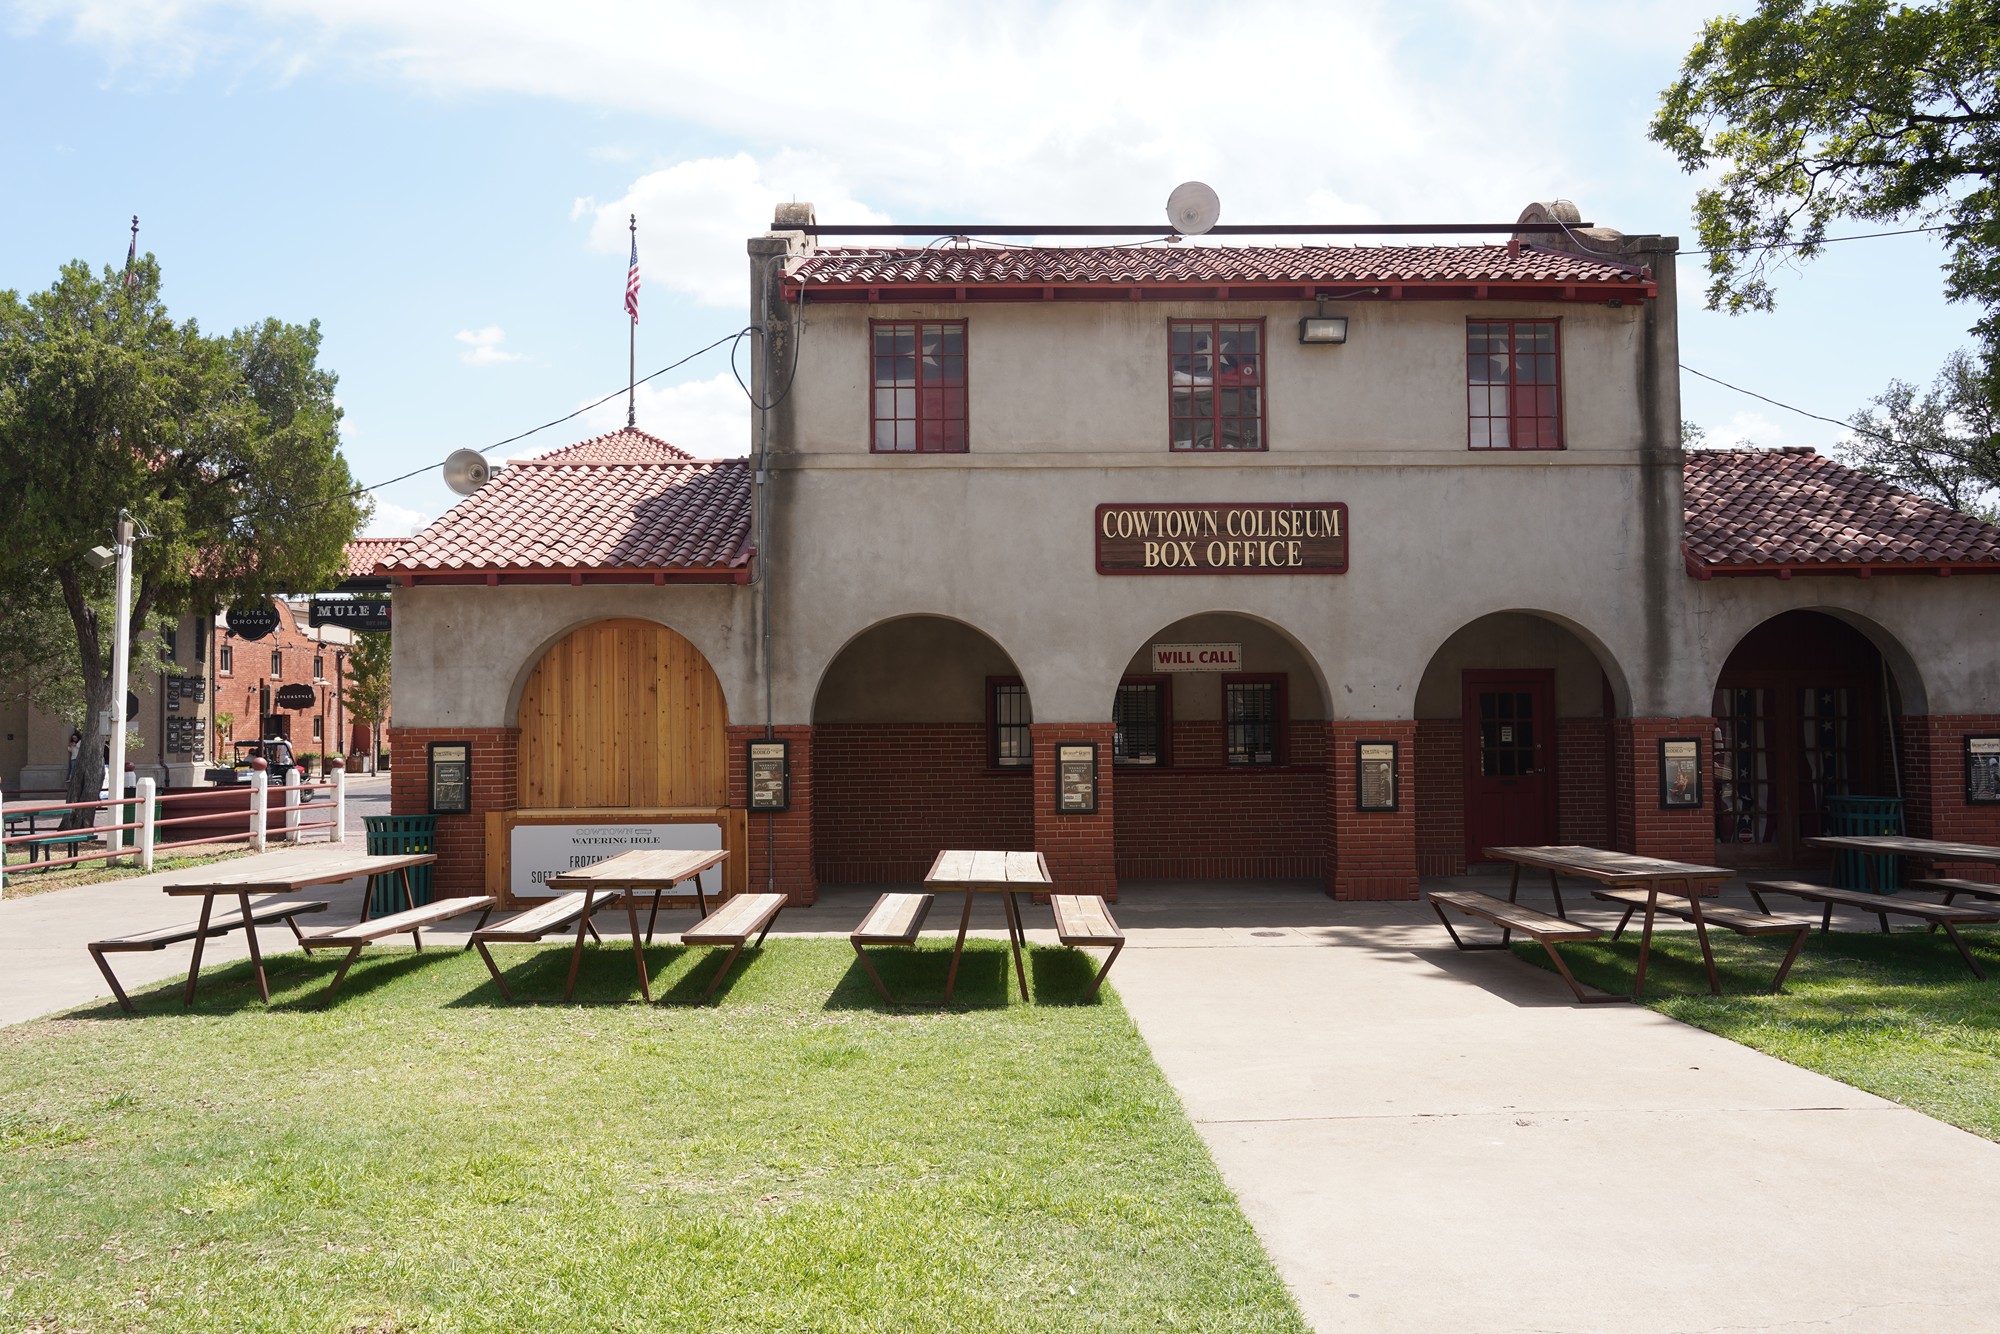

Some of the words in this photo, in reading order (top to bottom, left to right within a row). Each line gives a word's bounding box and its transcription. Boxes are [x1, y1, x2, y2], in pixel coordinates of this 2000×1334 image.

[1102, 510, 1218, 538] COWTOWN
[1226, 509, 1341, 538] COLISEUM
[1143, 541, 1197, 568] BOX
[1206, 540, 1303, 567] OFFICE
[317, 605, 370, 617] MULE
[1157, 651, 1195, 664] WILL
[1198, 651, 1237, 663] CALL
[576, 828, 634, 836] COWTOWN
[630, 836, 661, 844] HOLE
[569, 855, 603, 868] FROZEN
[531, 871, 553, 883] SOFT
